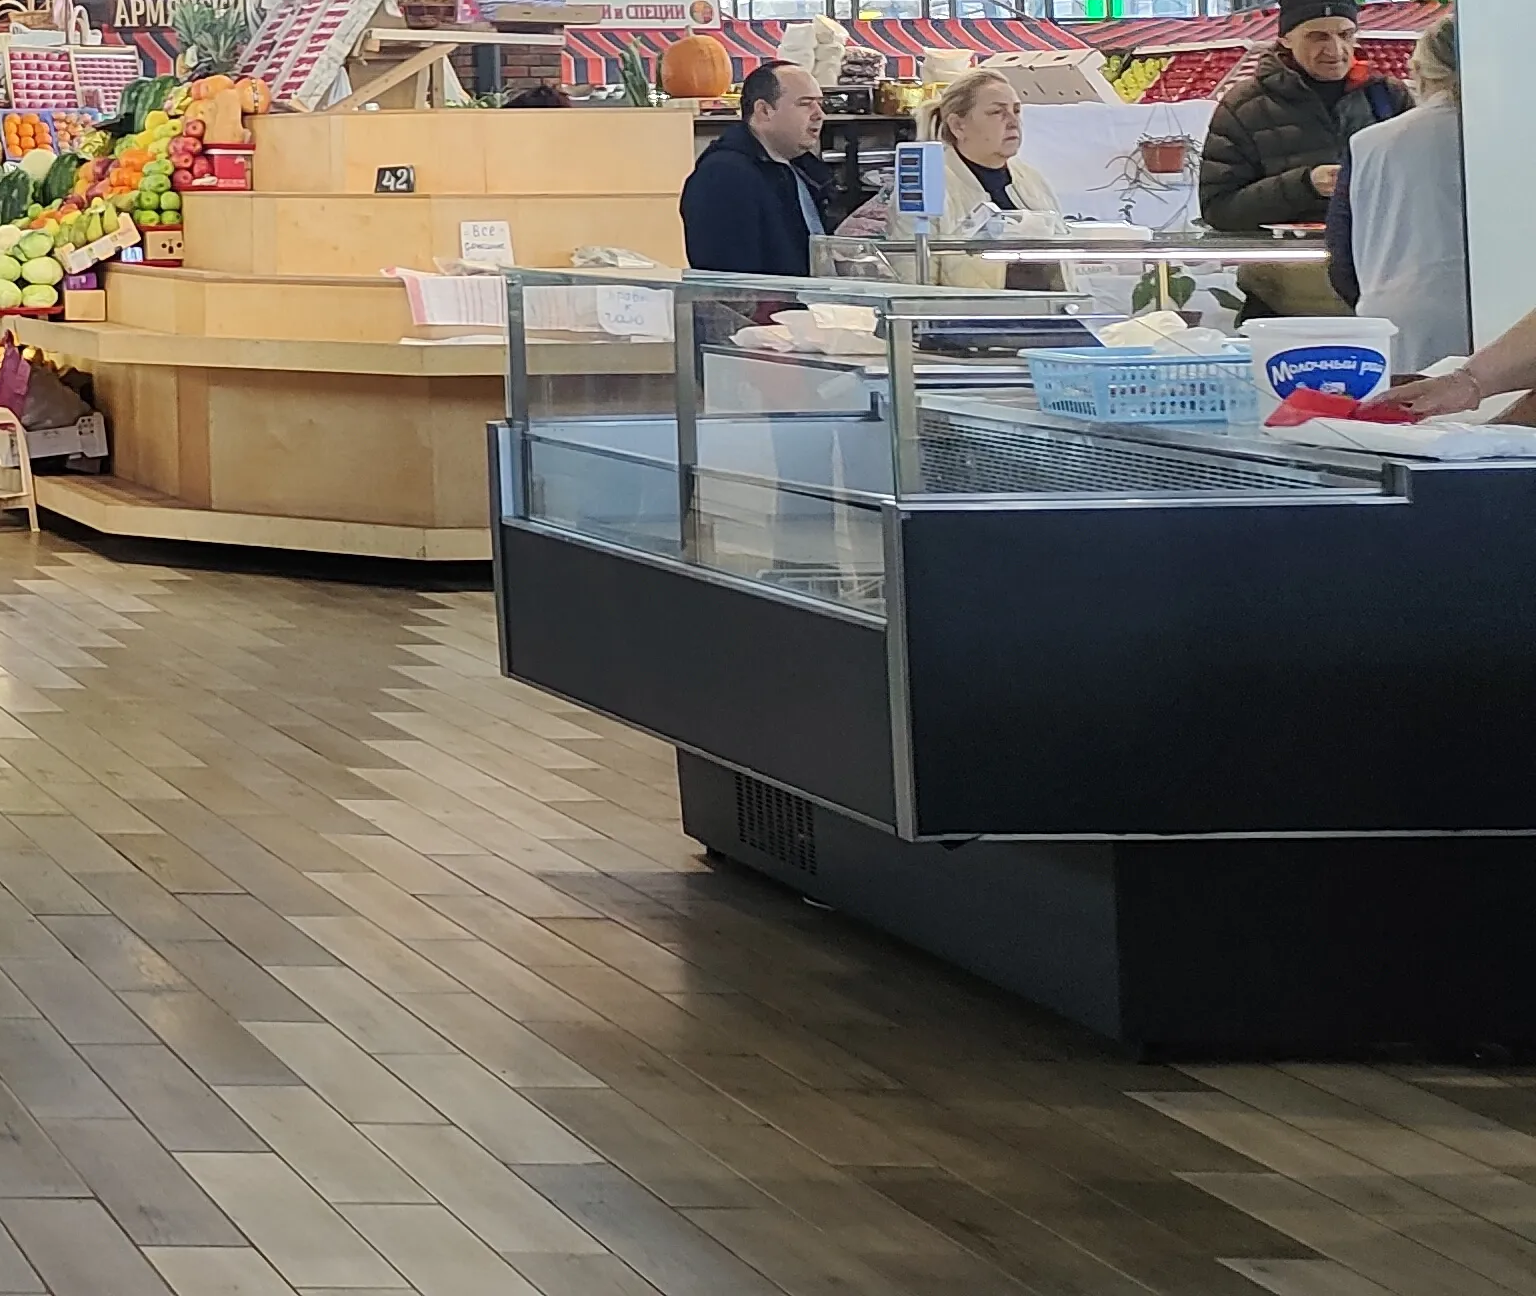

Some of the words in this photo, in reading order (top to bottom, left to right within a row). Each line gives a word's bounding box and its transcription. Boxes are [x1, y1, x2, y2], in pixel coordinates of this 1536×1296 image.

[626, 4, 686, 22] СПЕЦИИ
[381, 169, 409, 191] 42
[1271, 356, 1357, 386] Молочный
